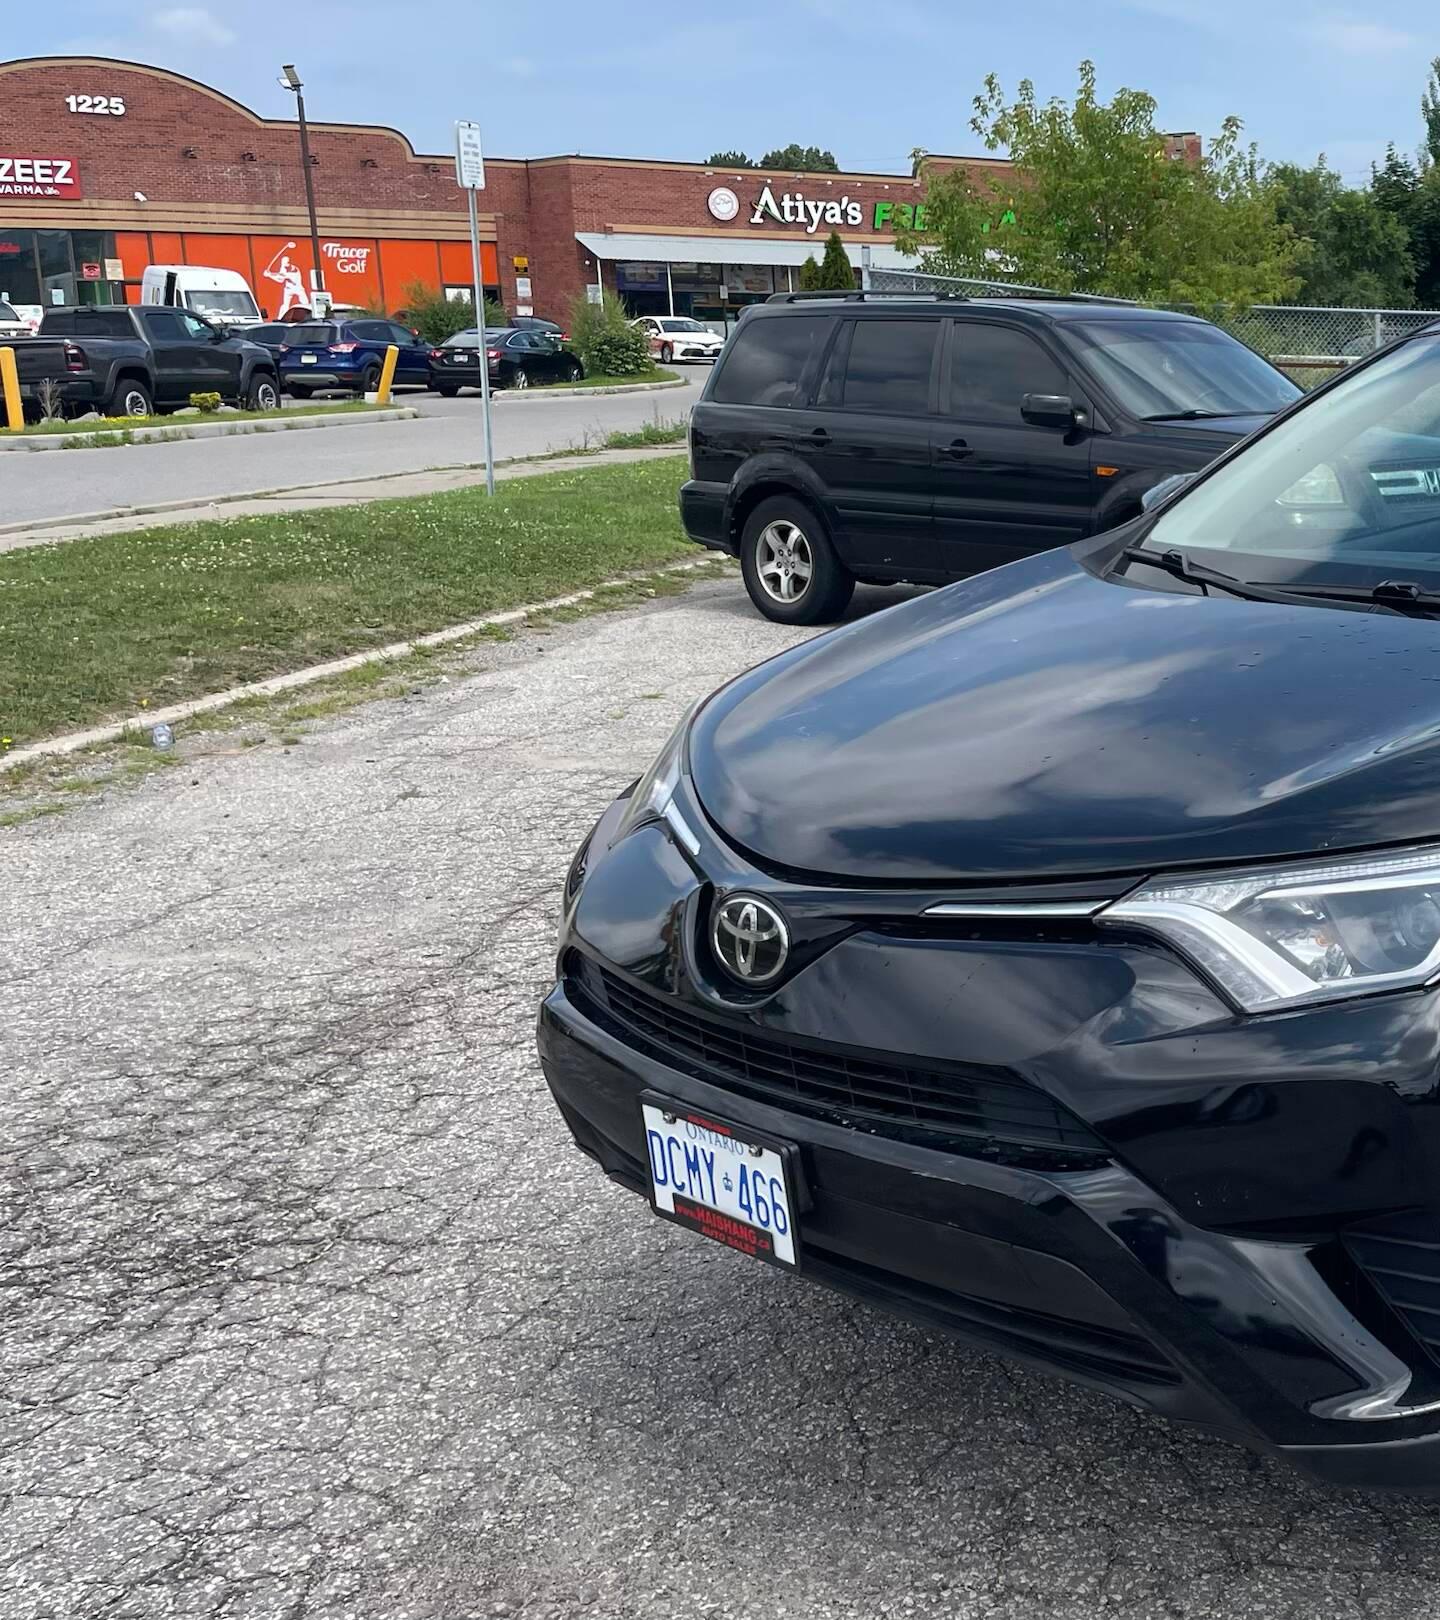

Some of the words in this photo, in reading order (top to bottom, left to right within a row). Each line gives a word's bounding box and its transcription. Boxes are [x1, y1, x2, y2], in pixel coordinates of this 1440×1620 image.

[65, 94, 126, 116] 1225
[750, 186, 863, 234] Atiya's
[322, 242, 371, 259] Tracer
[336, 258, 367, 274] Golf
[685, 1121, 744, 1156] ONTARIO
[648, 1129, 718, 1206] DCMY
[738, 1163, 788, 1235] 466
